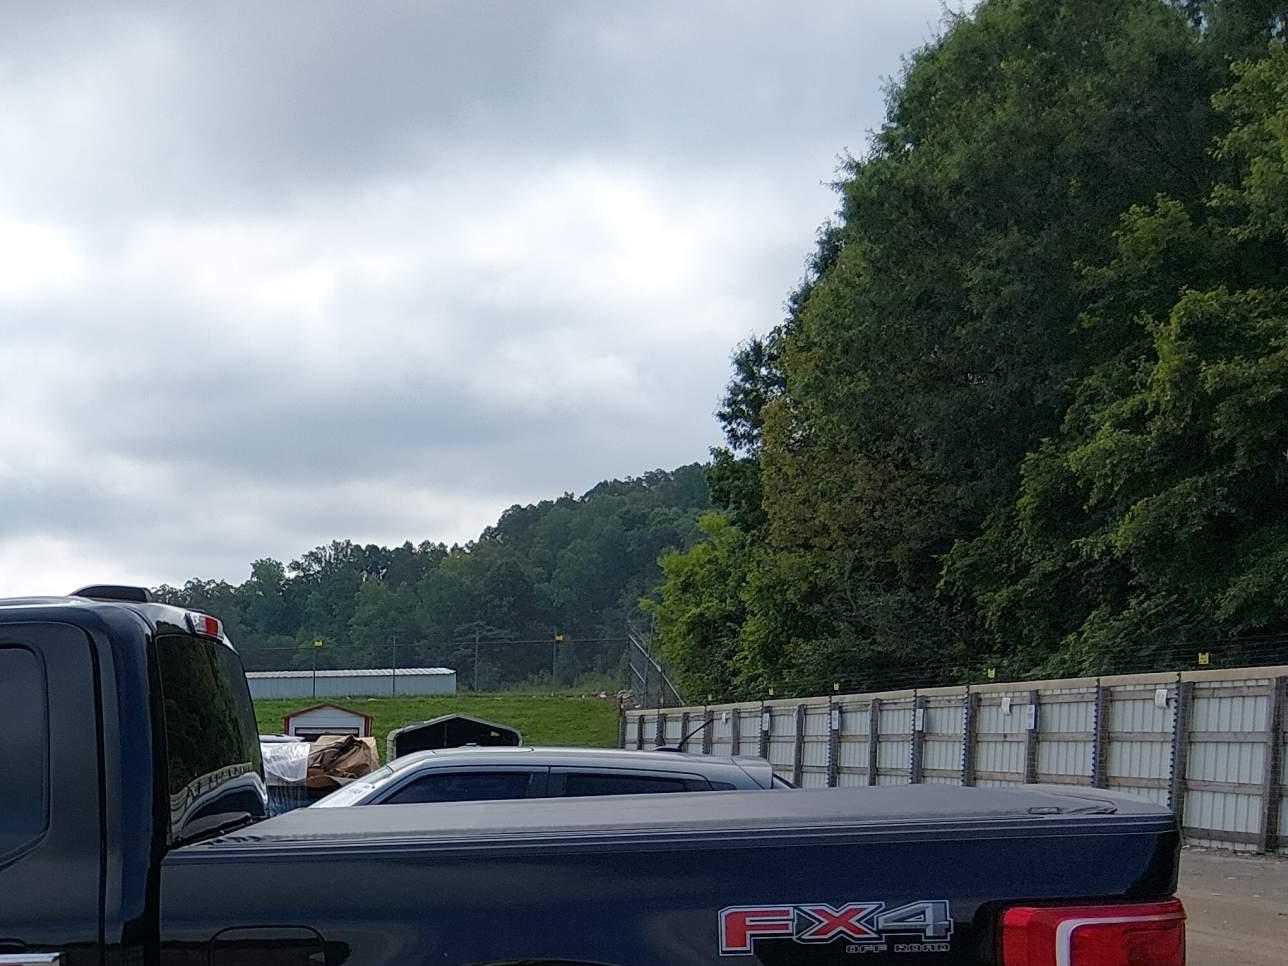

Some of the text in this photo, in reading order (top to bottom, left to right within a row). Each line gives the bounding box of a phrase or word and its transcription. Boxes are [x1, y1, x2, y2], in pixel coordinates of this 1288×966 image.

[718, 899, 954, 956] FX4
[845, 942, 951, 954] OFF ROAD
